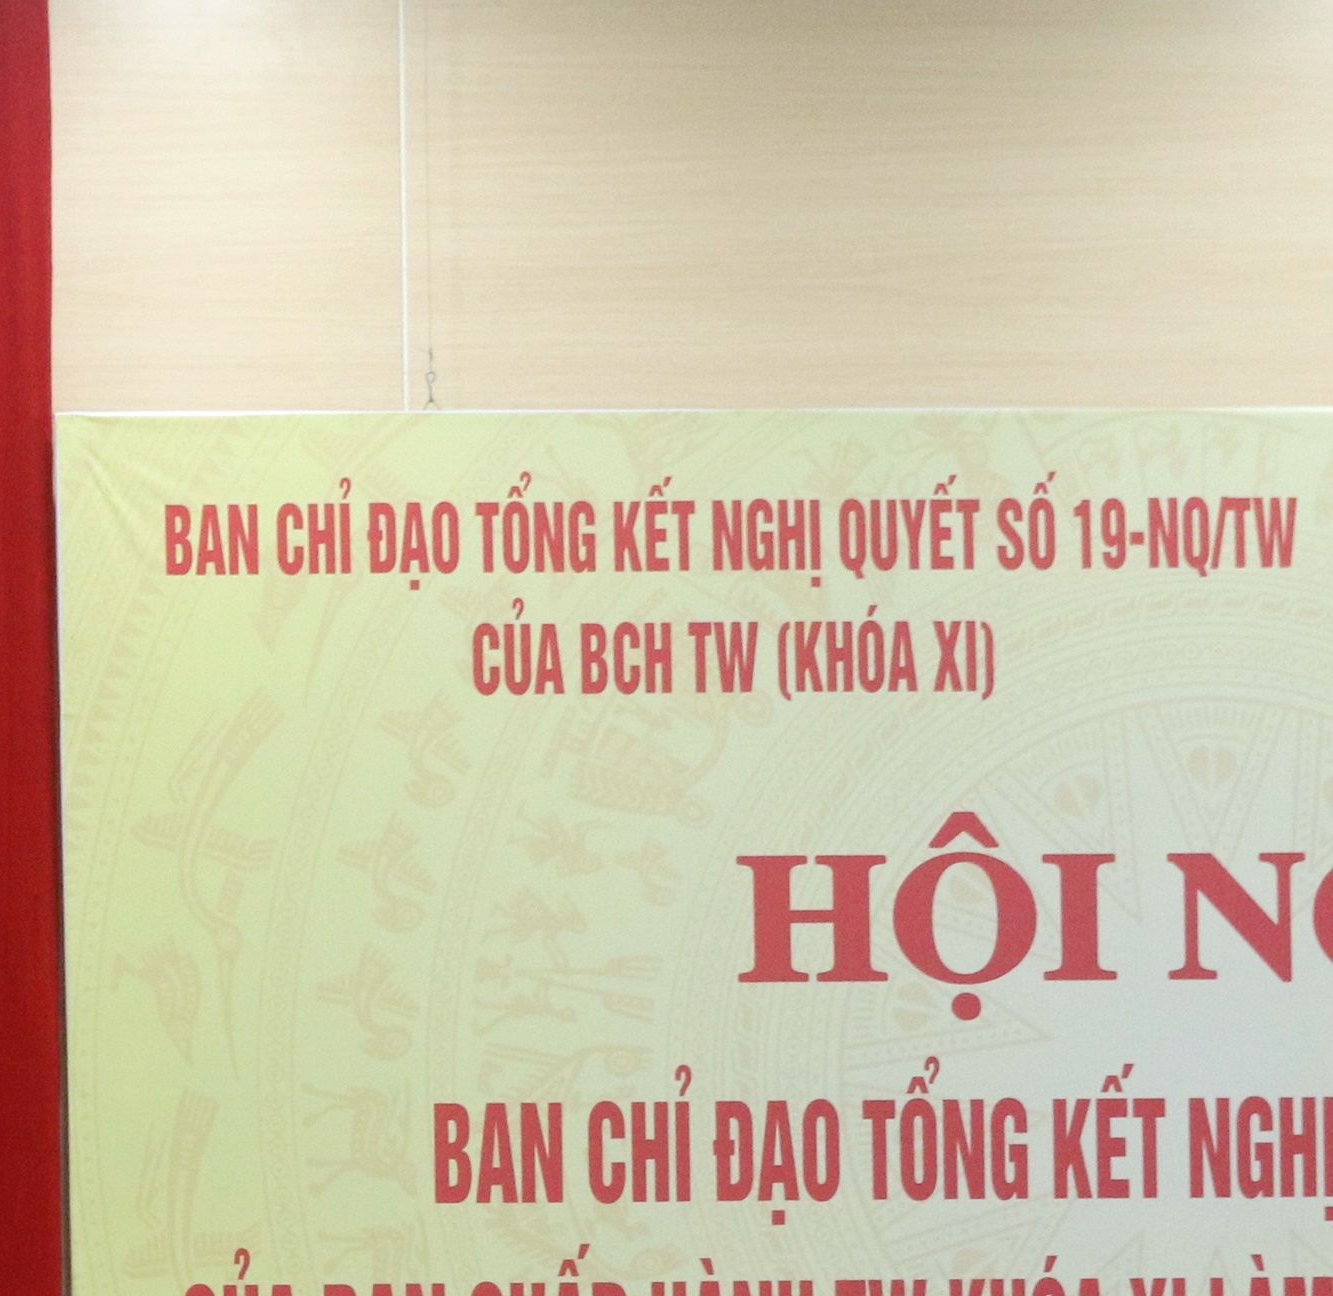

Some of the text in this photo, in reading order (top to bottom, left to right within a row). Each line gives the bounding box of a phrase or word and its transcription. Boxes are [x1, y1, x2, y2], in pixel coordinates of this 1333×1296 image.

[165, 471, 1298, 591] BAN CHỈ ĐẠO TỔNG KẾT NGHỊ QUYẾT SỐ 19-NQ/TW
[472, 597, 995, 700] CỦA BCH TW (KHÓA XI)
[736, 811, 1333, 1021] HỘI N
[434, 1102, 565, 1204] BAN
[587, 1064, 692, 1204] CHỈ
[713, 1099, 841, 1226] ĐẠO
[862, 1056, 1030, 1201] TỔNG
[1053, 1063, 1167, 1200] KẾT
